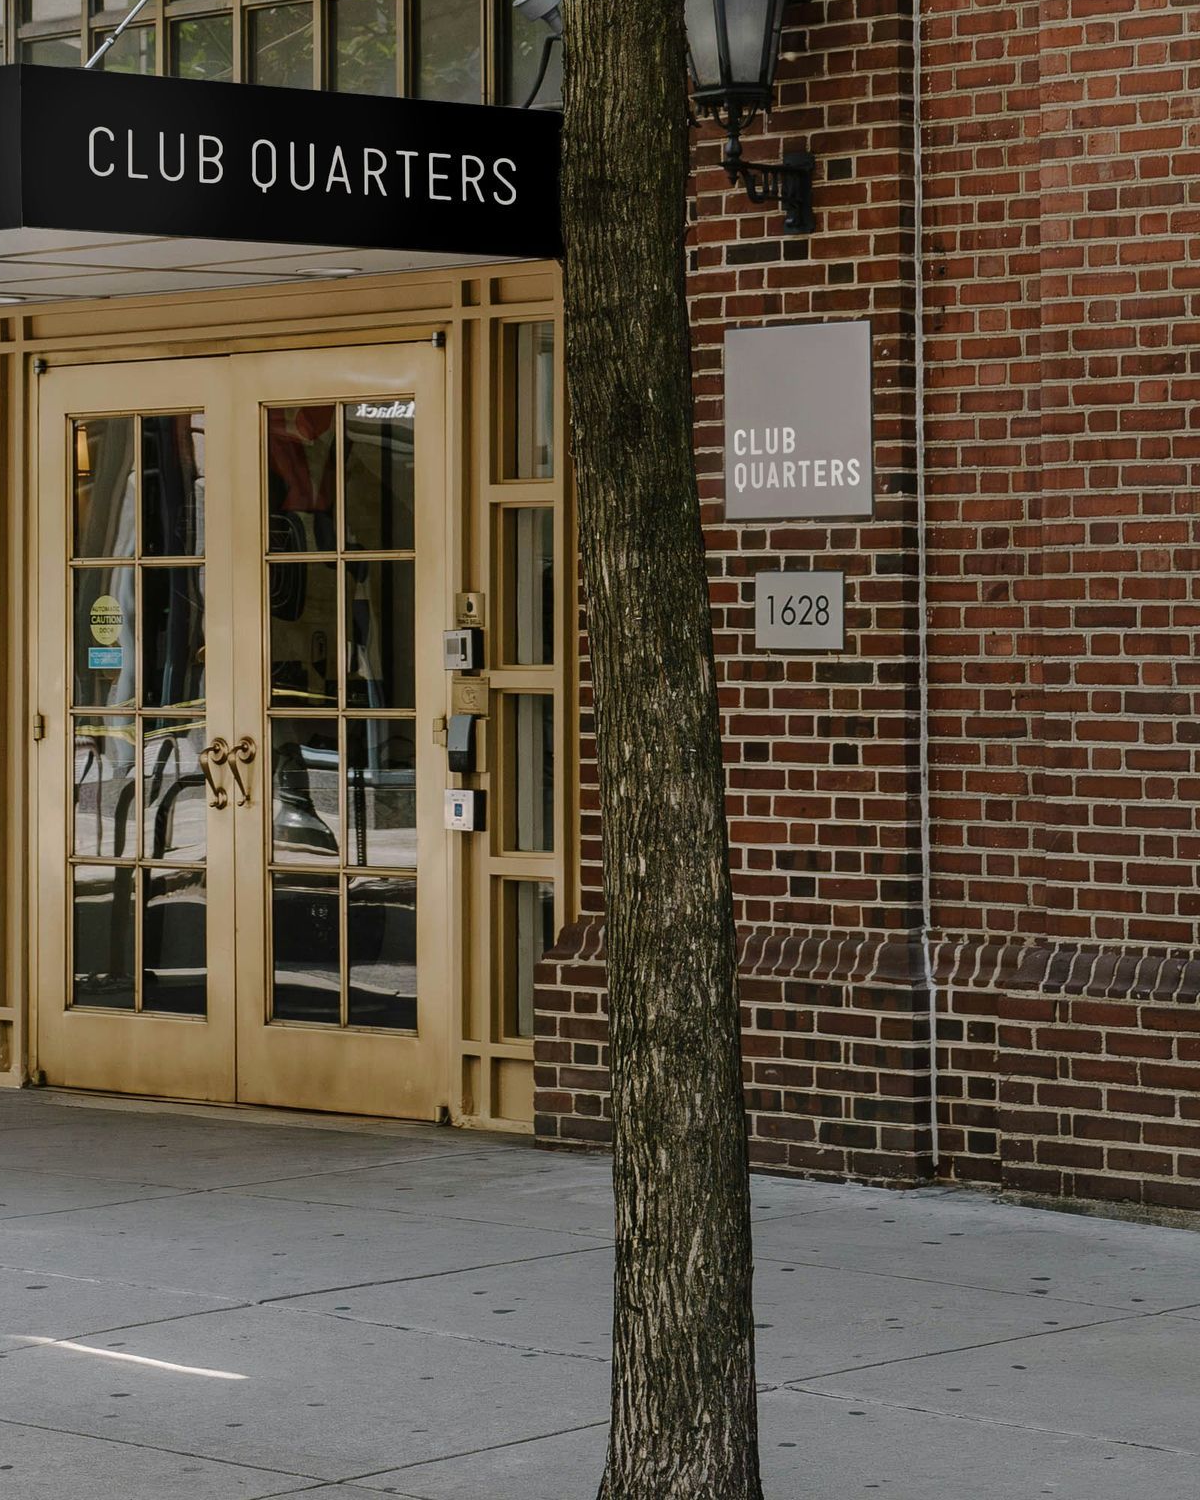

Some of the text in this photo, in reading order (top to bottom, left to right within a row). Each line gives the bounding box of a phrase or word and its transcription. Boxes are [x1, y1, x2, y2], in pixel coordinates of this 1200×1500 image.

[89, 126, 517, 206] CLUB QUARTERS
[734, 427, 796, 455] CLUB
[734, 458, 861, 492] QUARTERS
[91, 615, 122, 624] CAUTION
[767, 595, 830, 626] 1628
